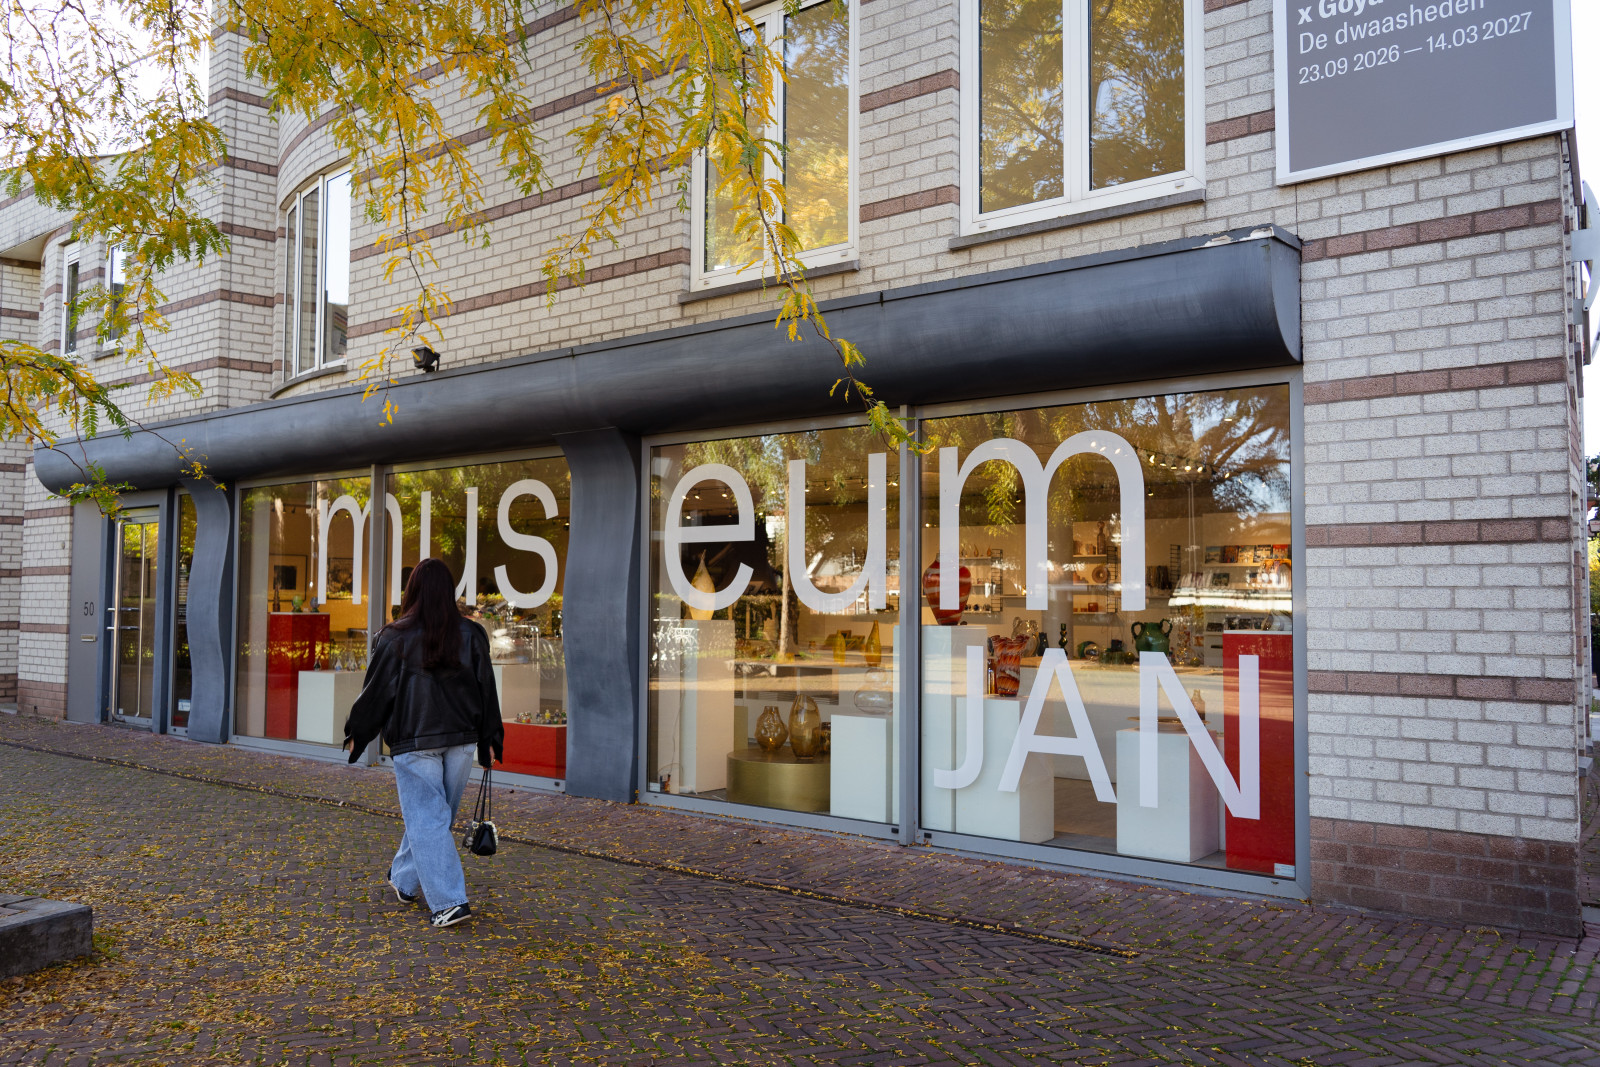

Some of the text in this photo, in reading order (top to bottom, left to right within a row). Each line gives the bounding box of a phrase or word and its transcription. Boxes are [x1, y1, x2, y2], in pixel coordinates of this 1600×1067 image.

[1298, 0, 1384, 25] x Goy
[1299, 57, 1348, 84] 23.09
[1353, 44, 1400, 72] 2026
[1426, 25, 1478, 53] 14.03
[1482, 10, 1532, 41] 2027
[1300, 32, 1328, 54] De
[83, 601, 95, 617] 50
[934, 645, 1260, 820] JAN
